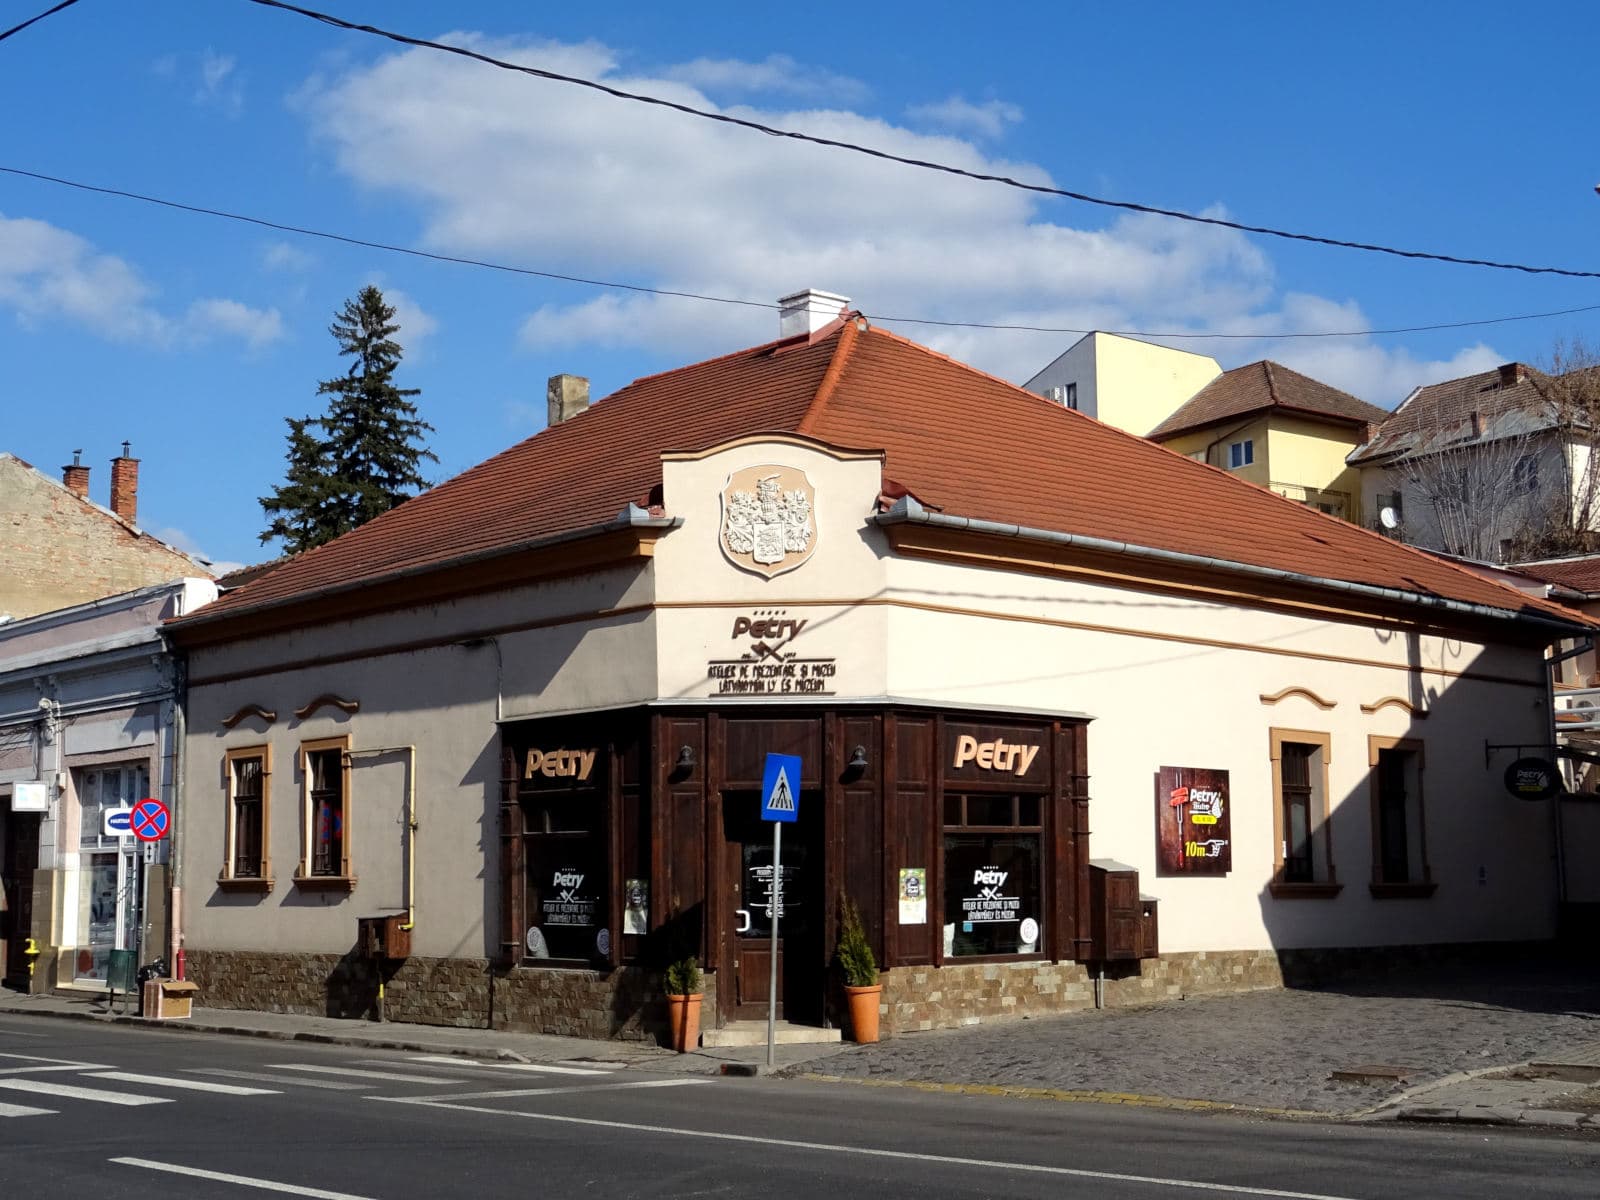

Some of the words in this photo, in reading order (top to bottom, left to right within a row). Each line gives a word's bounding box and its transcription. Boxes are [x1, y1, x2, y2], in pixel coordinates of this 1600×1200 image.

[731, 616, 809, 642] Petry
[525, 745, 598, 781] Petry
[953, 735, 1040, 777] Petry
[1189, 788, 1218, 804] Petry
[1184, 841, 1206, 857] 10m
[552, 871, 585, 889] Petry
[973, 869, 1008, 887] Petry
